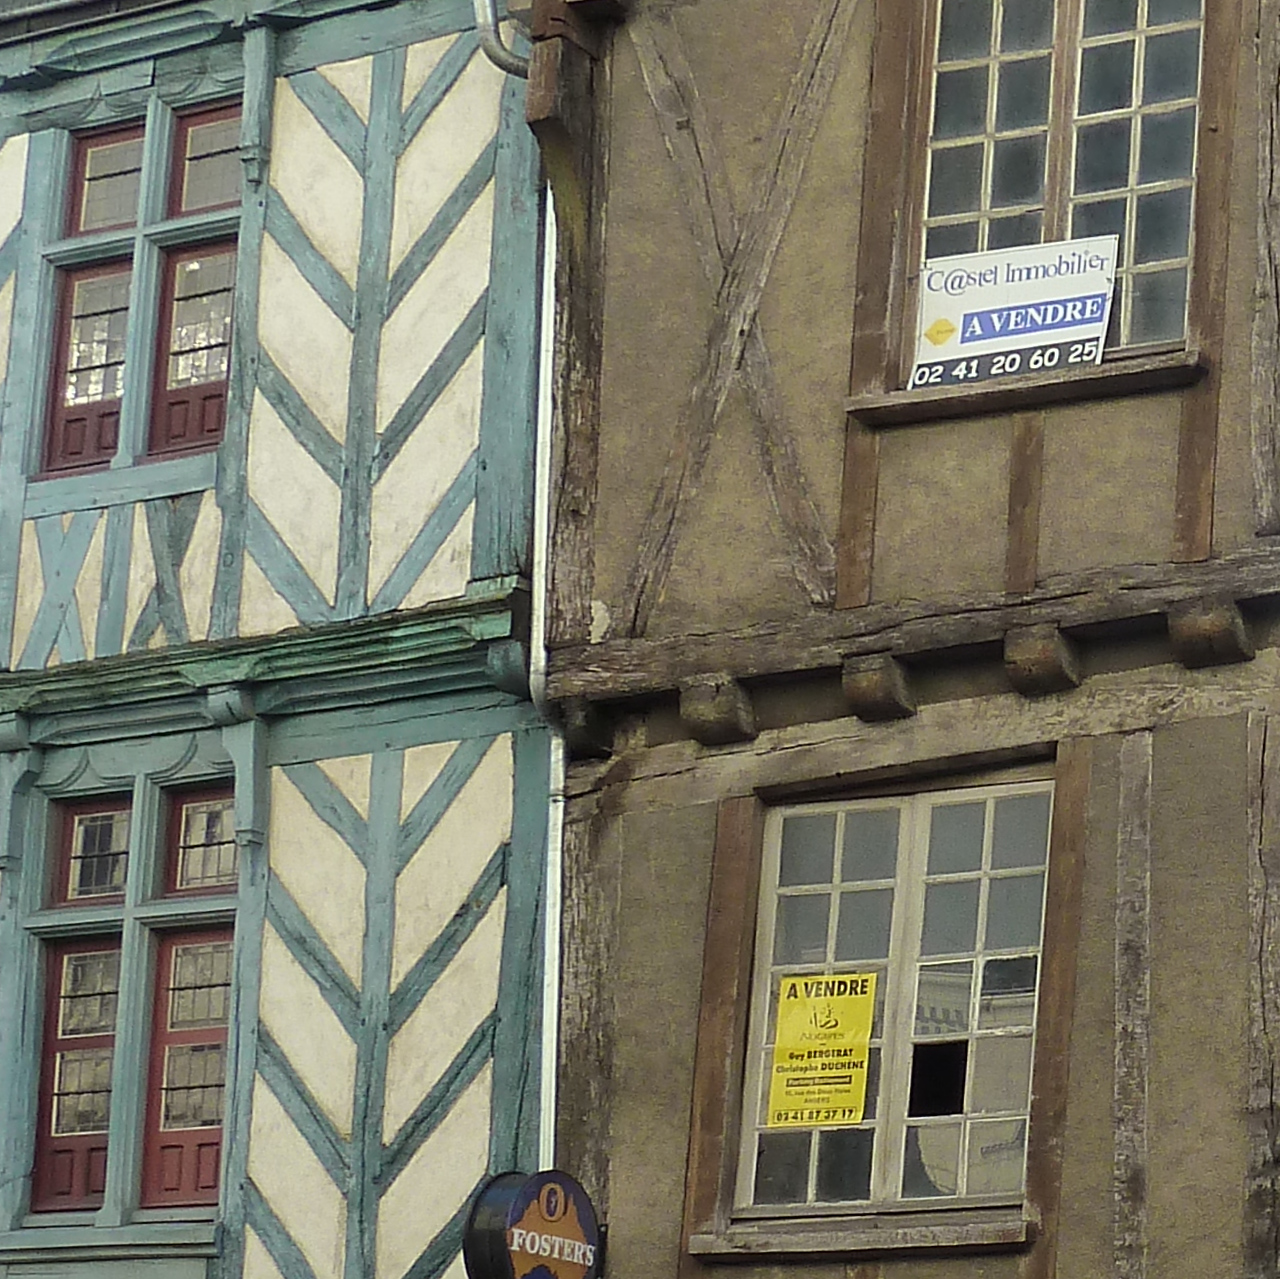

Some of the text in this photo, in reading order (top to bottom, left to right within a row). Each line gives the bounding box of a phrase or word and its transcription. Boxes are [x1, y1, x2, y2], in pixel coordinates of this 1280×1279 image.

[1006, 250, 1109, 283] Immobilier
[965, 317, 983, 337] A
[991, 298, 1101, 331] VENDRE
[914, 341, 1098, 384] 02 41 20 60 25
[787, 979, 869, 999] A VENDRE
[842, 1109, 854, 1118] 17
